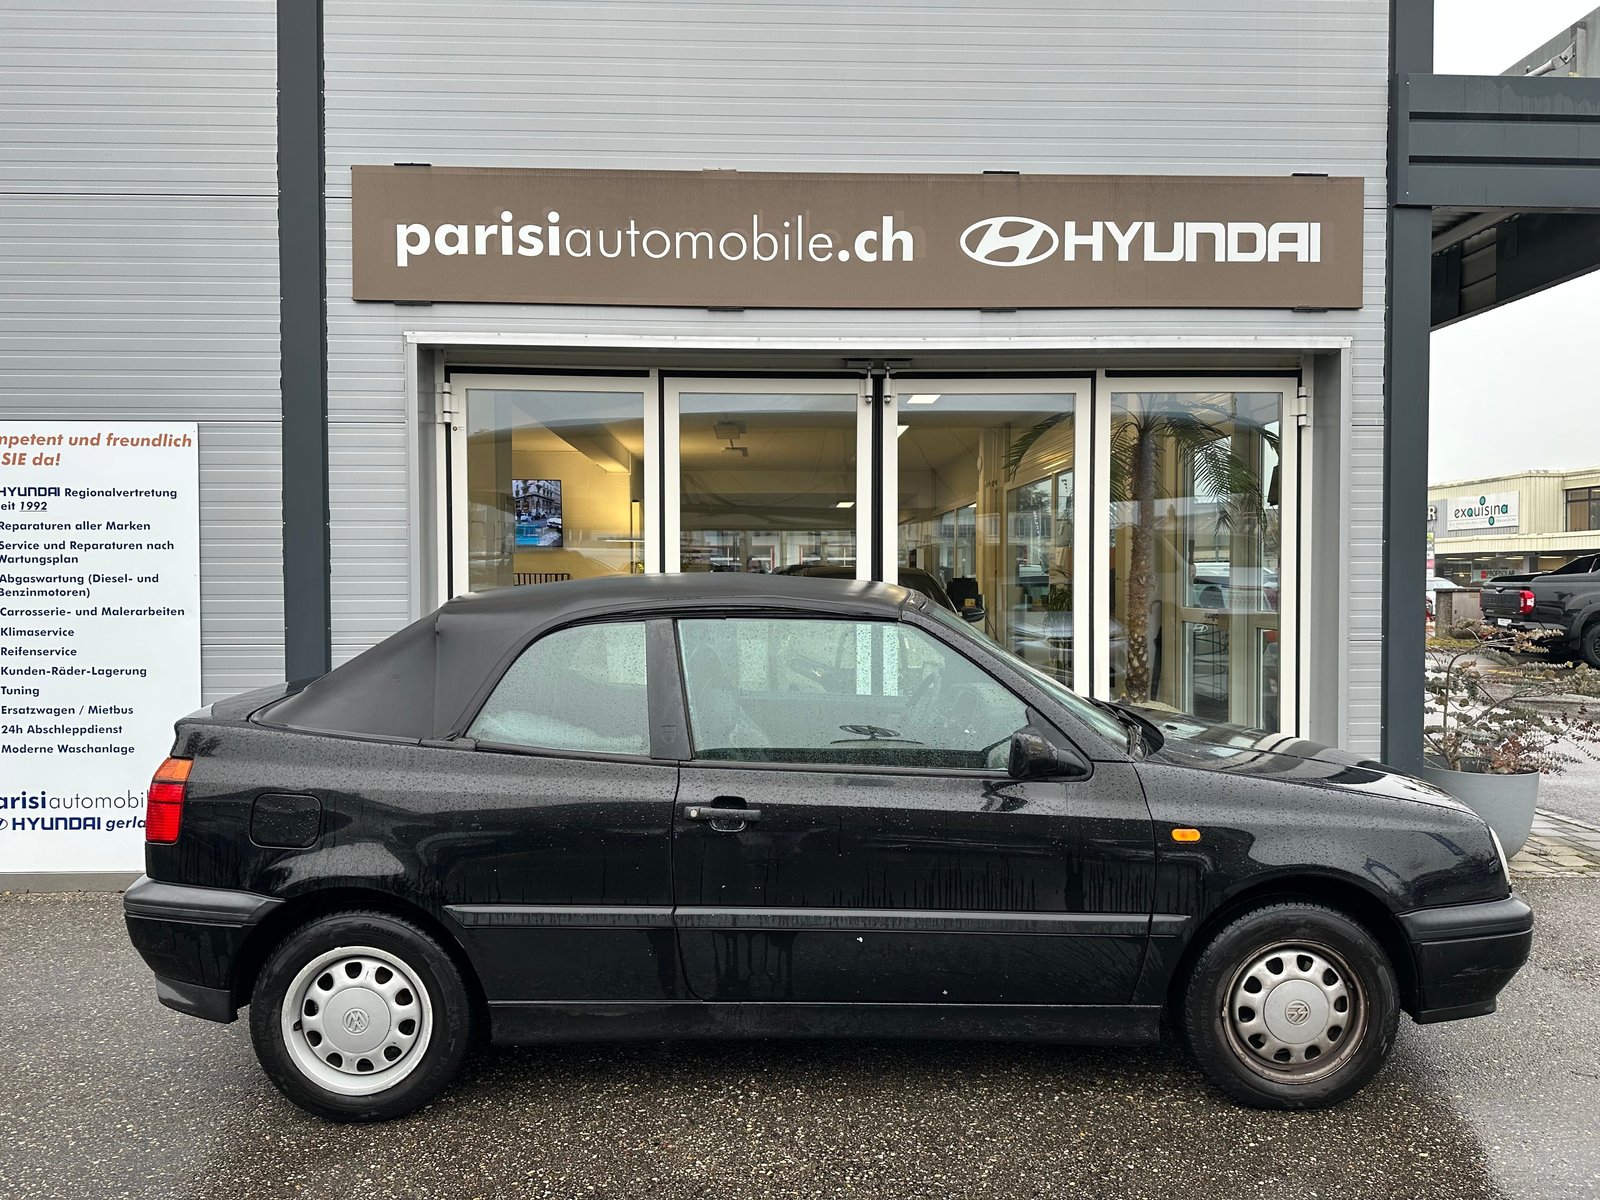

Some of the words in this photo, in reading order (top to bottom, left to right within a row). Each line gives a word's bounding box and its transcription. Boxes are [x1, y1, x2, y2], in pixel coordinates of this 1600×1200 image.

[397, 211, 913, 266] parisiautomobile.ch
[1065, 221, 1320, 262] HYUNDAI
[69, 433, 100, 446] und
[106, 432, 192, 447] freundlich
[1, 453, 27, 466] SIE
[32, 452, 61, 466] da!
[65, 487, 177, 499] Regionalvertretung
[19, 501, 47, 513] 1992
[75, 521, 102, 531] aller
[106, 521, 151, 531] Marken
[44, 540, 66, 550] und
[70, 540, 143, 552] Reparaturen
[147, 540, 175, 550] nach
[0, 574, 85, 585] Abgaswartung
[88, 573, 133, 585] (Diesel-
[137, 573, 159, 583] und
[0, 606, 72, 617] Carrosserie-
[75, 606, 98, 616] und
[101, 606, 185, 616] Malerarbeiten
[0, 627, 75, 637] Klimaservice
[0, 647, 77, 656] Reifenservice
[1, 666, 147, 677] Kunden-Räder-Lagerung
[1, 686, 40, 697] Tuning
[1, 706, 75, 717] Ersatzwagen
[79, 705, 84, 715] /
[88, 705, 134, 715] Mietbus
[1, 725, 23, 734] 24h
[27, 725, 123, 736] Abschleppdienst
[1, 744, 53, 754] Moderne
[57, 744, 135, 755] Waschanlage
[12, 817, 101, 830] HYUNDAI
